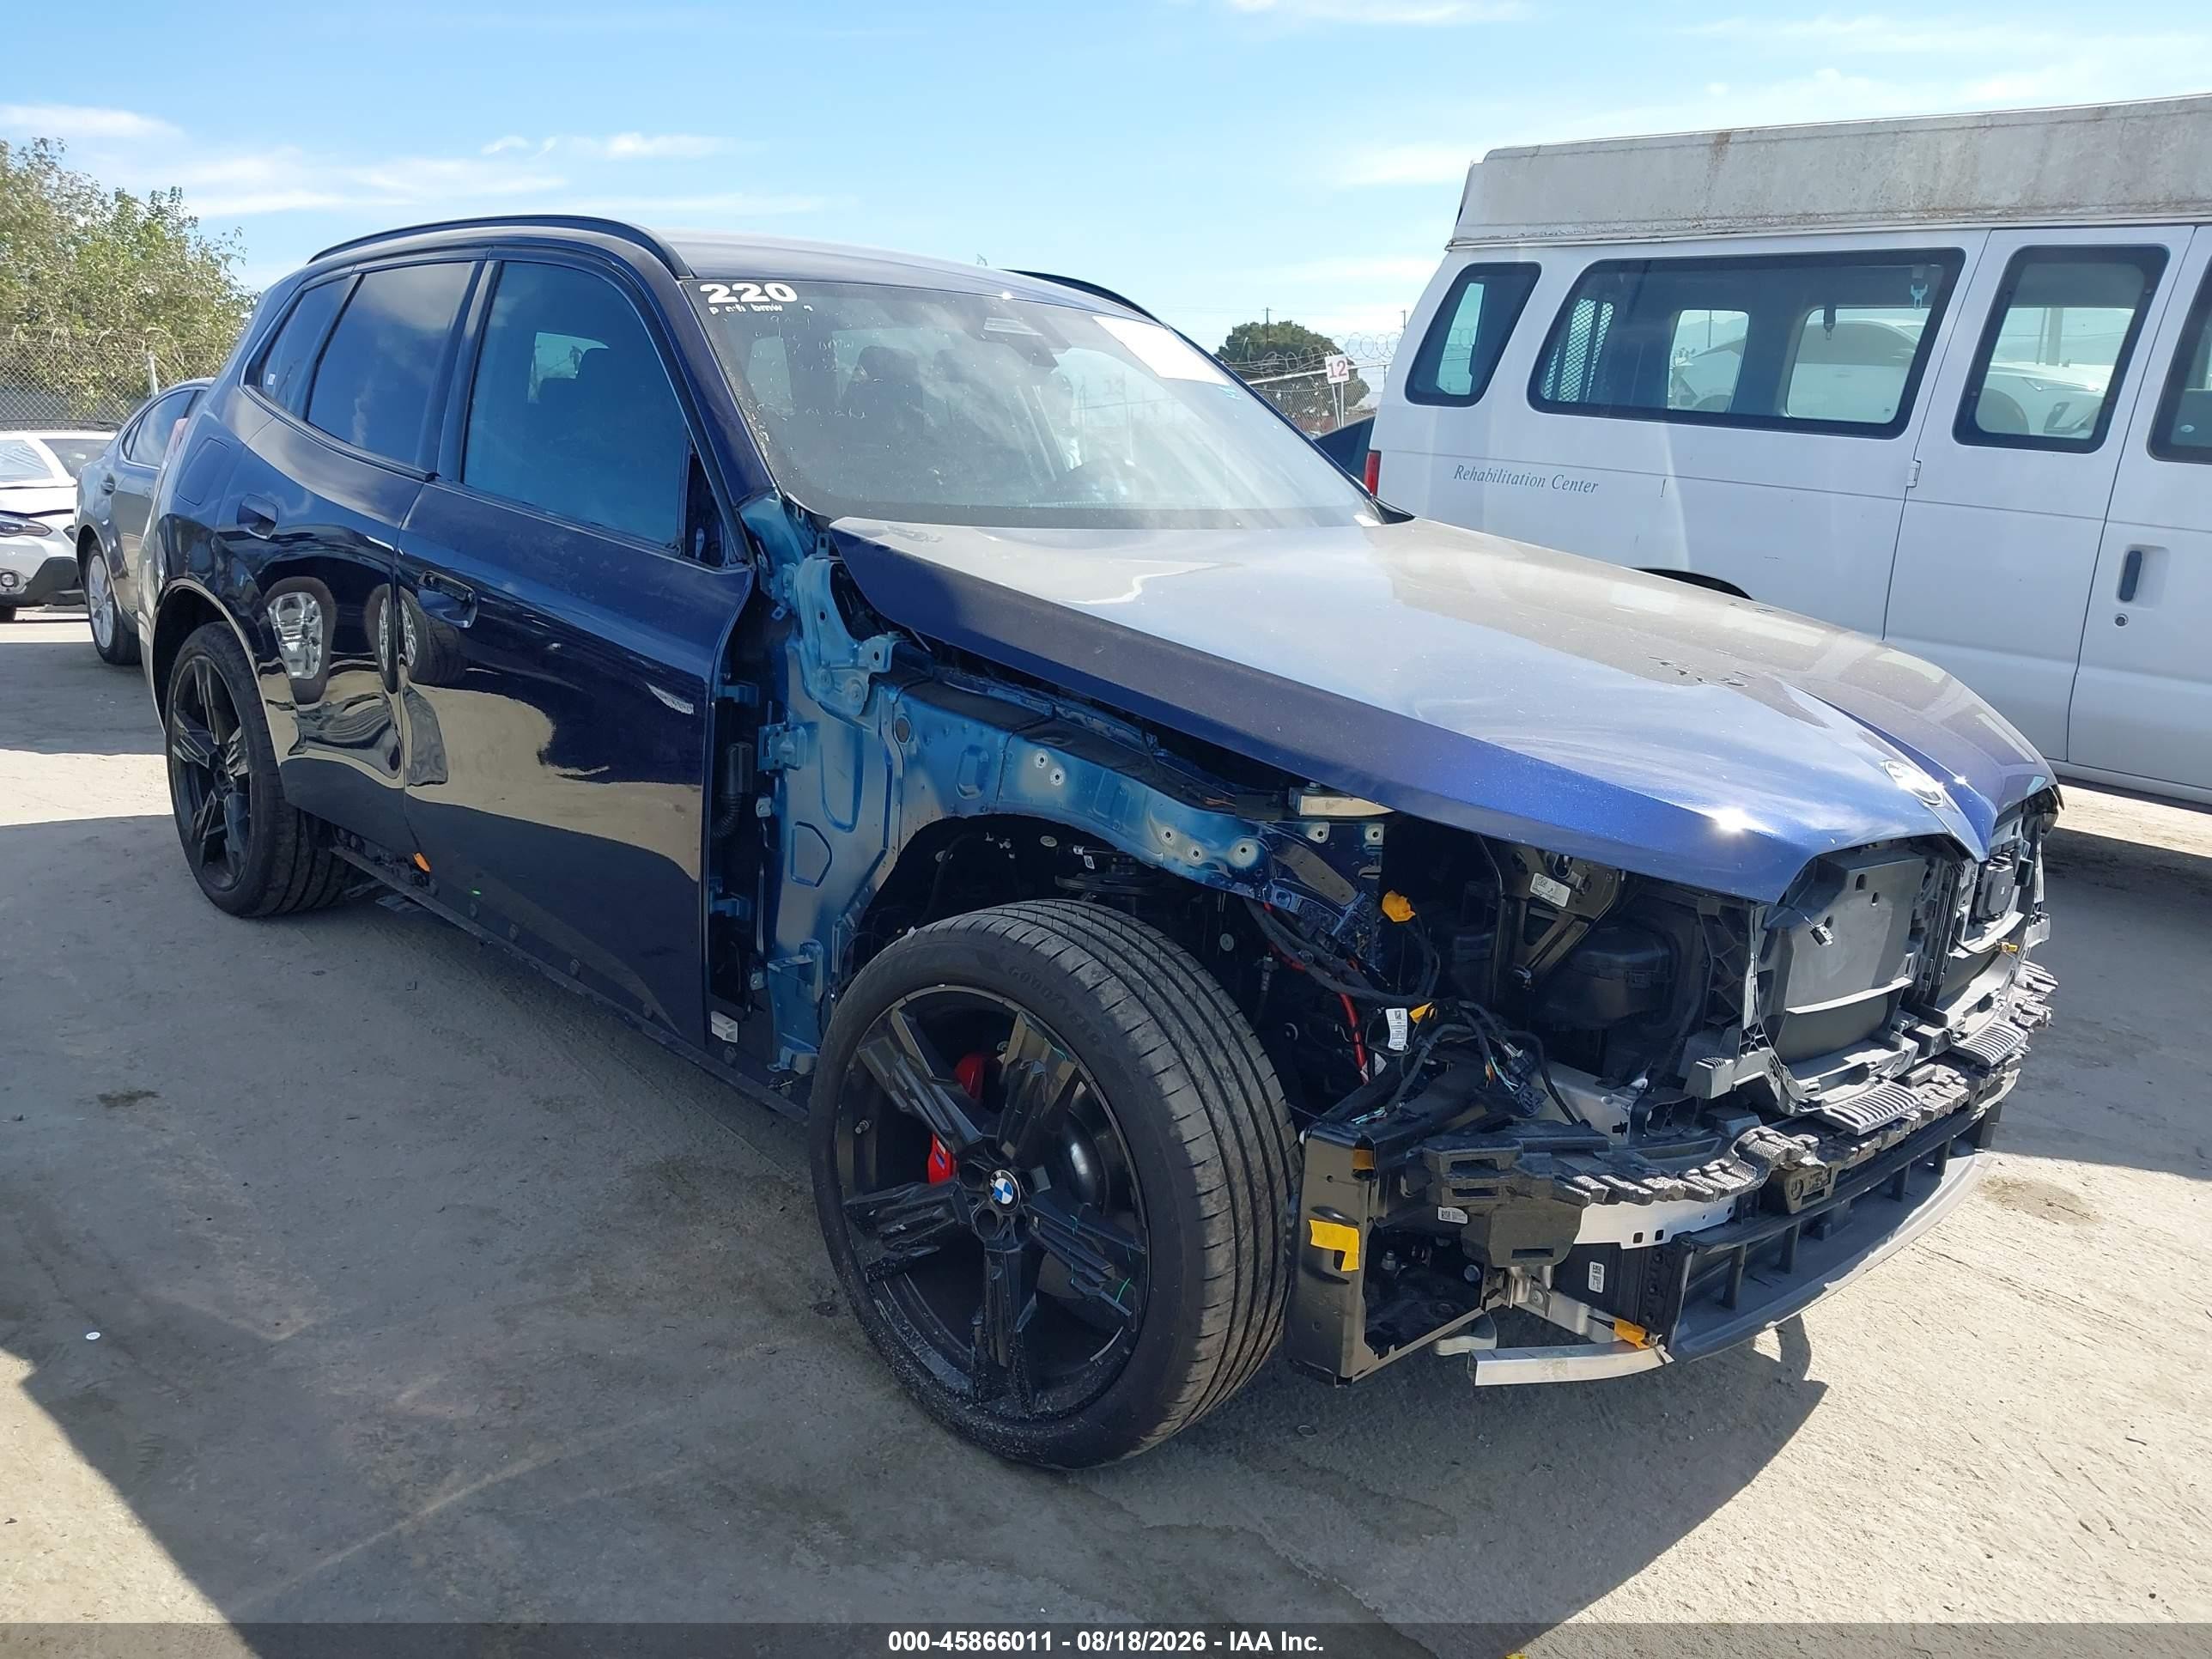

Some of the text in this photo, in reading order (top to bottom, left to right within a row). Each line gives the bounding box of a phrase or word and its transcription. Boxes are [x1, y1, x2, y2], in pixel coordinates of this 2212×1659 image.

[699, 283, 798, 304] 220
[1328, 360, 1346, 378] 12
[1454, 464, 1599, 494] Rehabilitation Center
